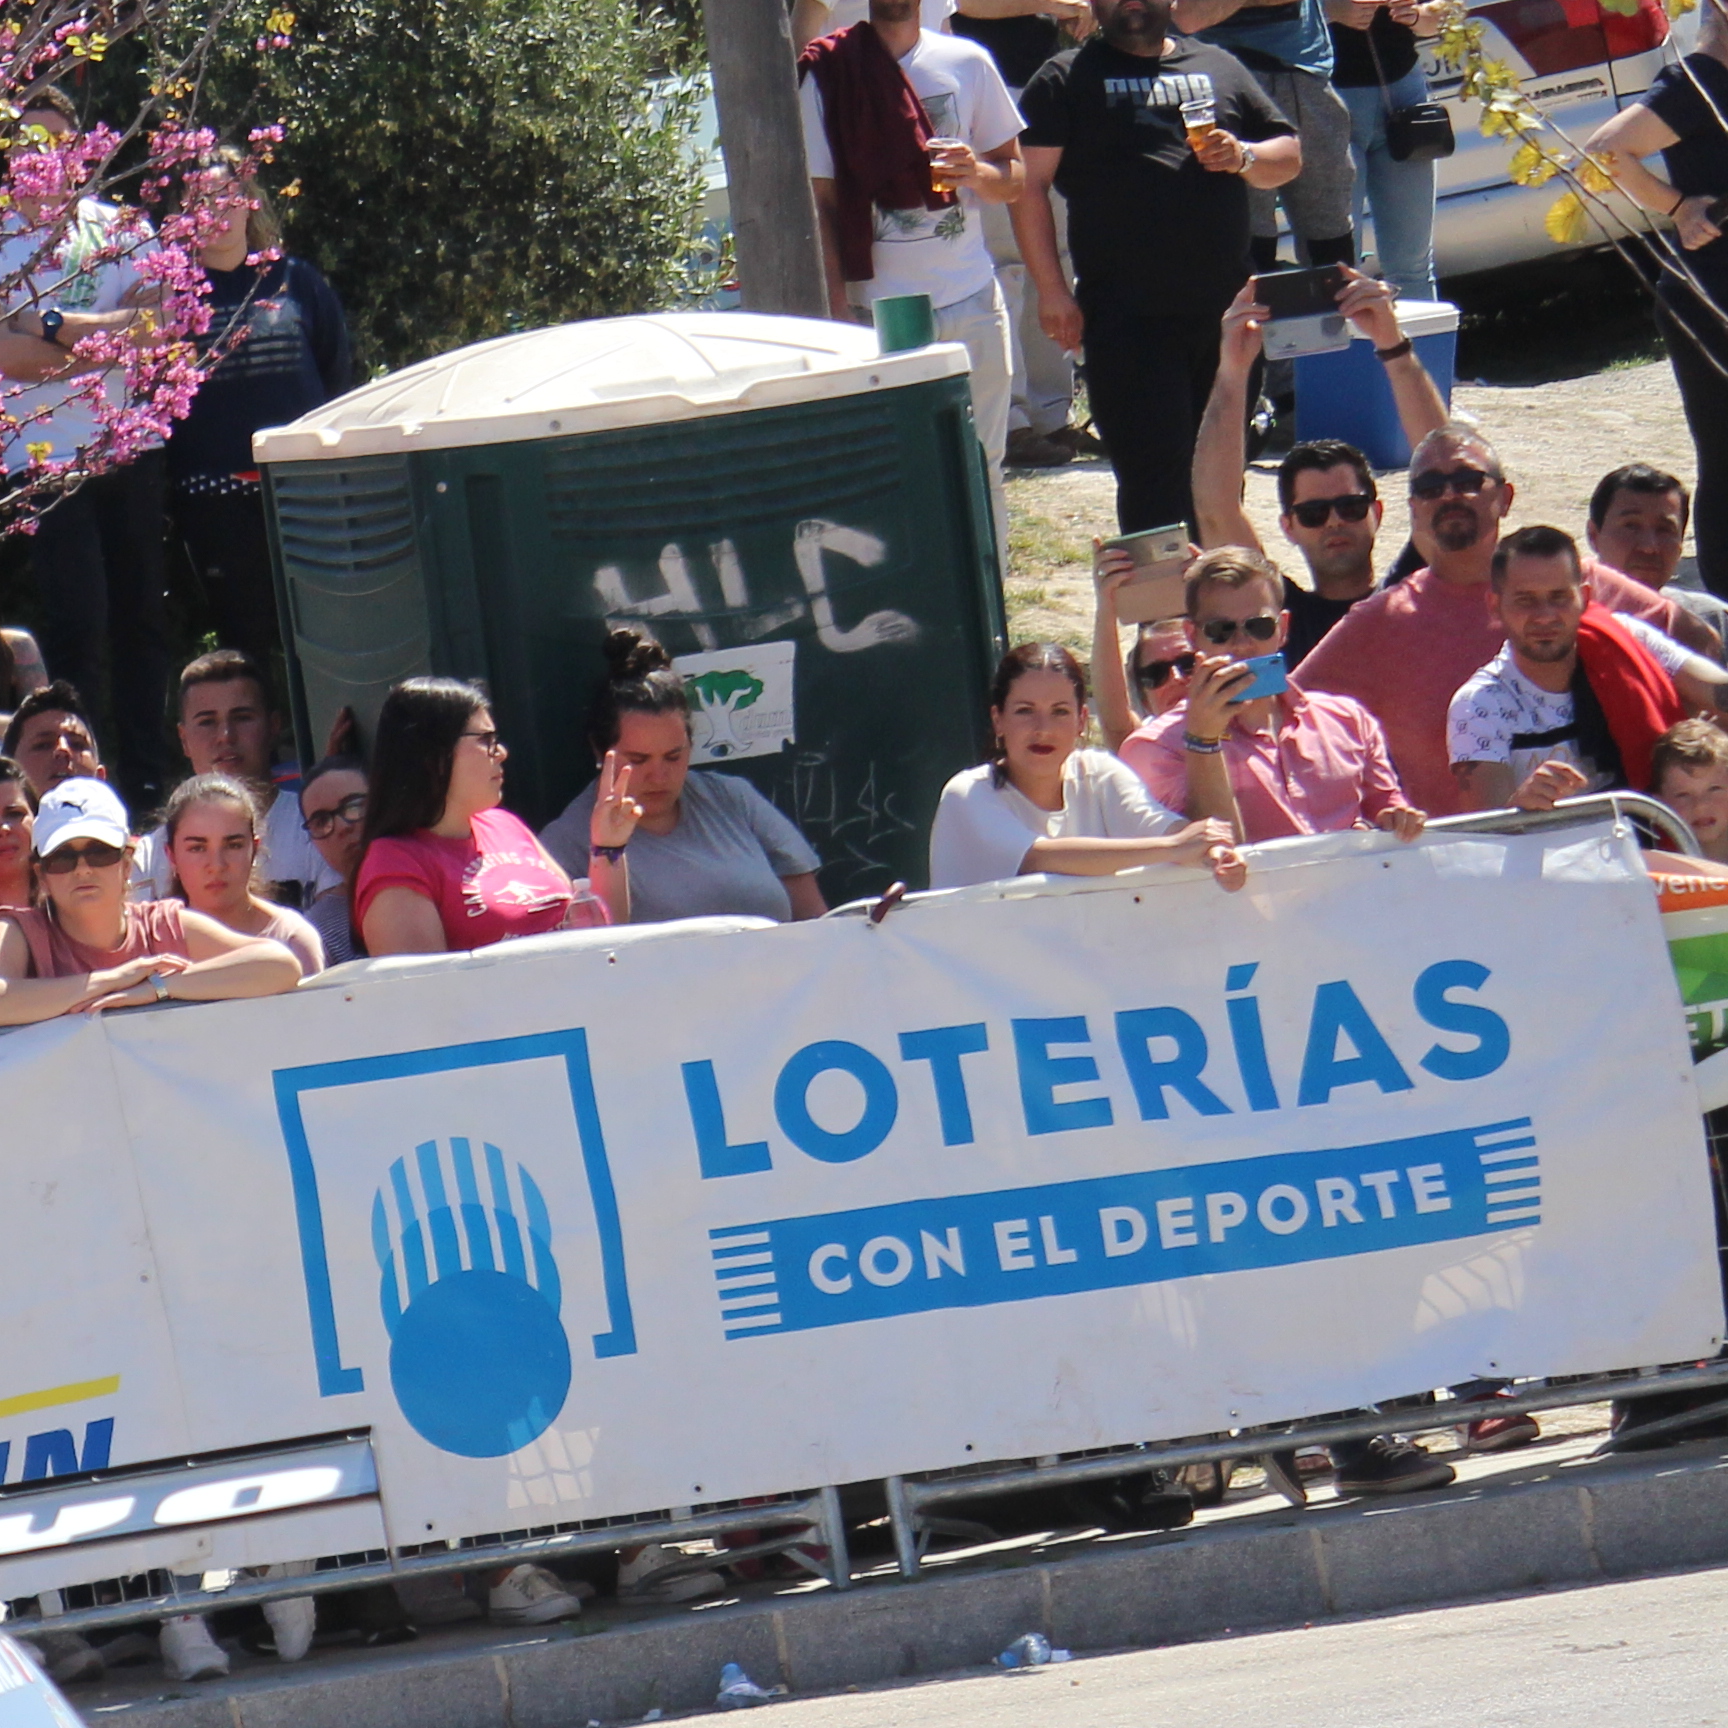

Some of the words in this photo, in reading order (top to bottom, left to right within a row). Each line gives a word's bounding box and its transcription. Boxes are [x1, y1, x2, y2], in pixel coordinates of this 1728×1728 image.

[1104, 73, 1214, 108] PUMA
[682, 960, 1511, 1180] LOTERÍAS
[808, 1226, 965, 1296] CON
[998, 1213, 1077, 1274] EL
[1103, 1162, 1452, 1259] DEPORTE
